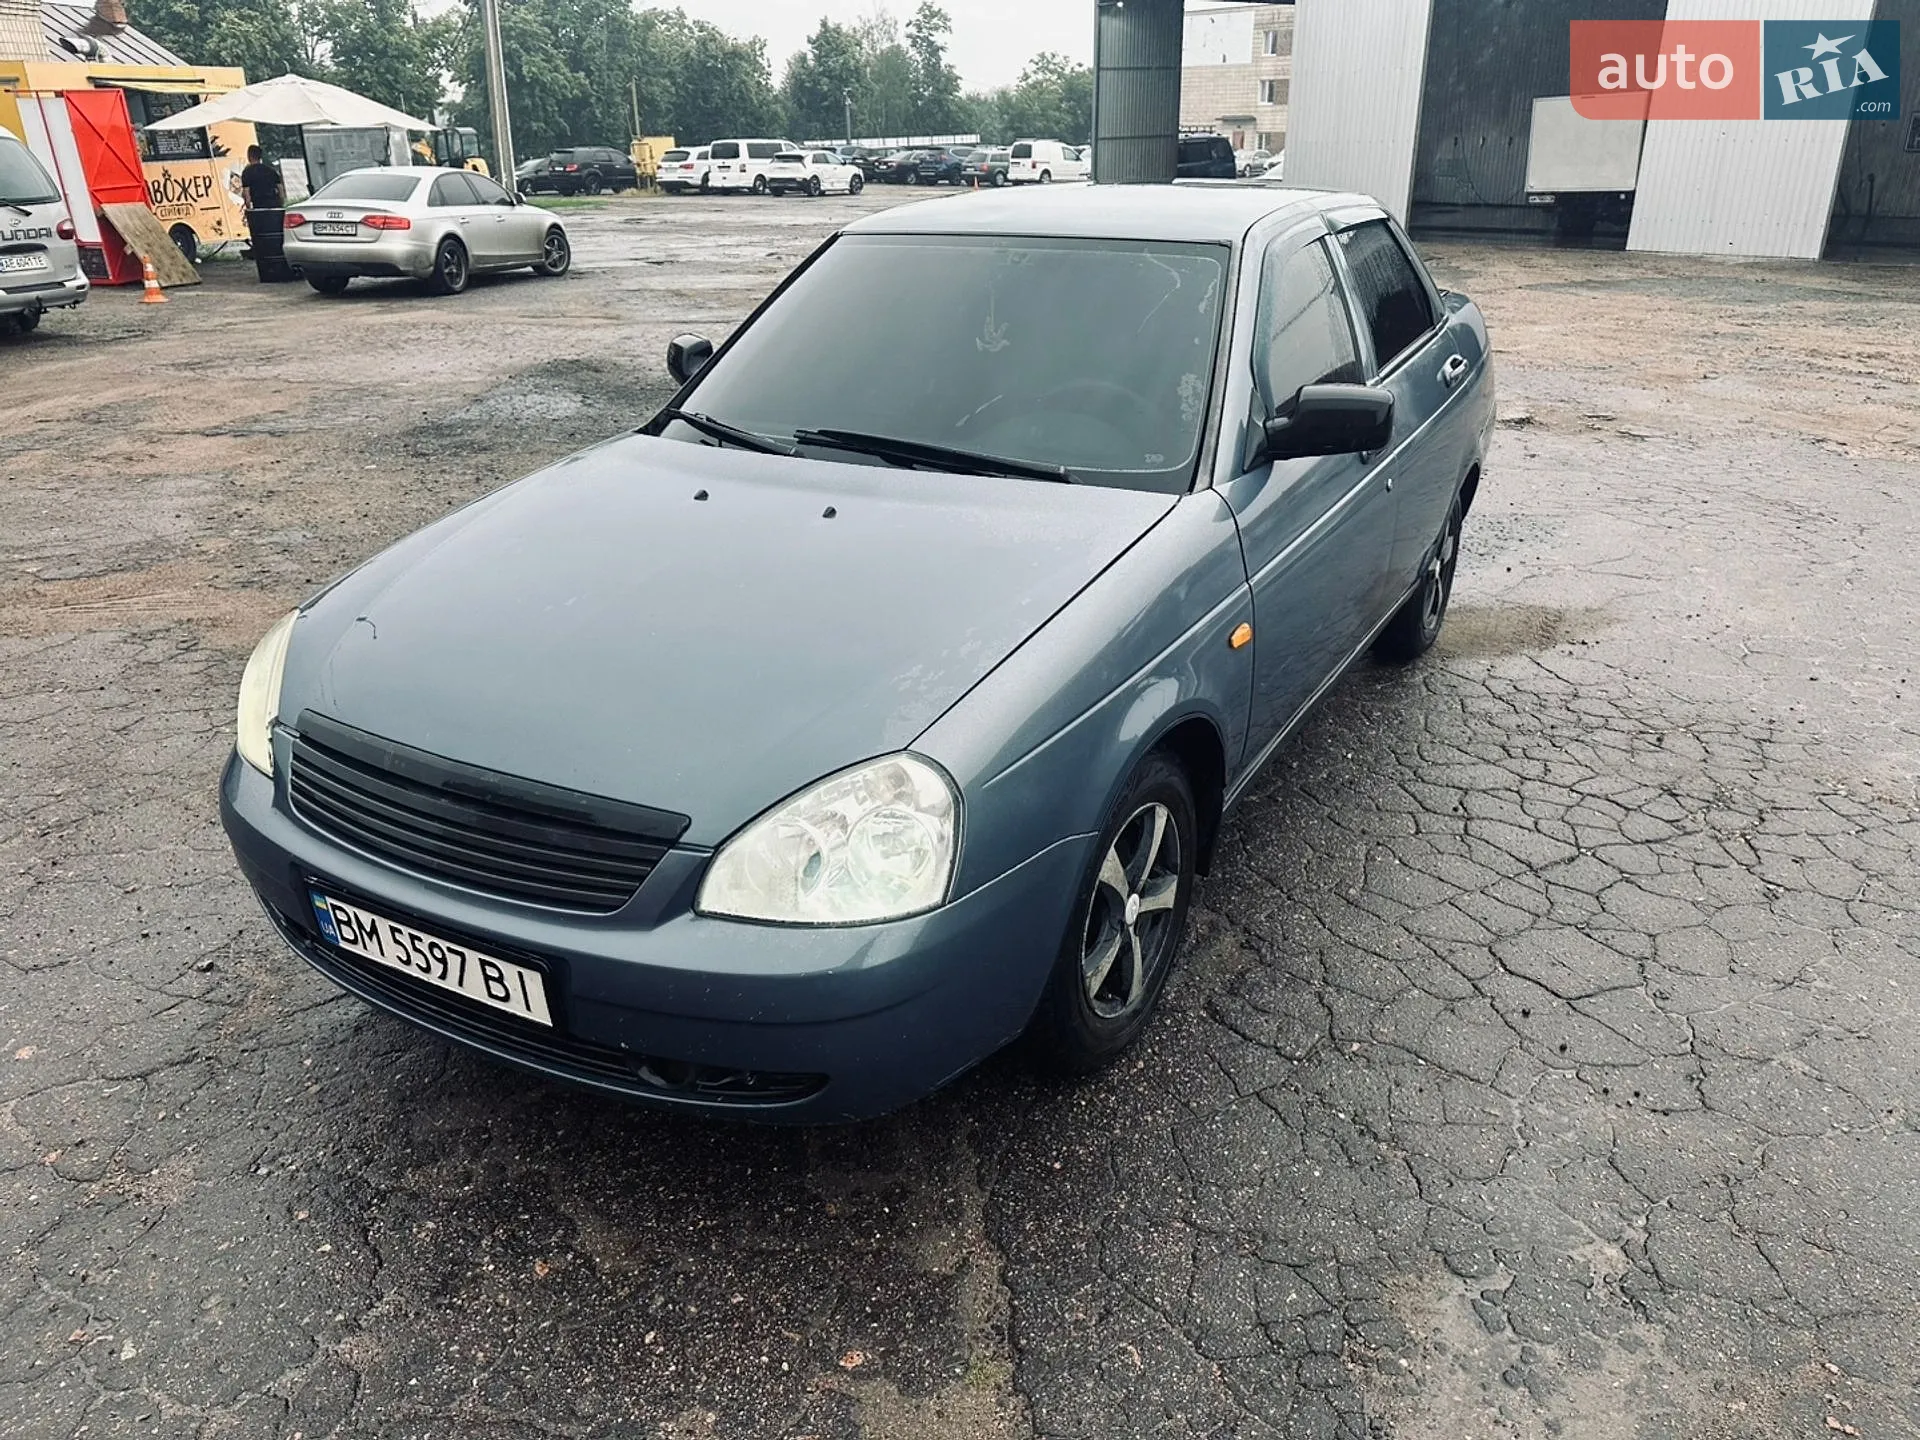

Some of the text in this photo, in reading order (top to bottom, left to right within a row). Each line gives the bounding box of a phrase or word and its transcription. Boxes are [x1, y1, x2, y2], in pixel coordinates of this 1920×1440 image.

[0, 226, 52, 241] UNDAI
[329, 902, 533, 1013] BM 5597 BI
